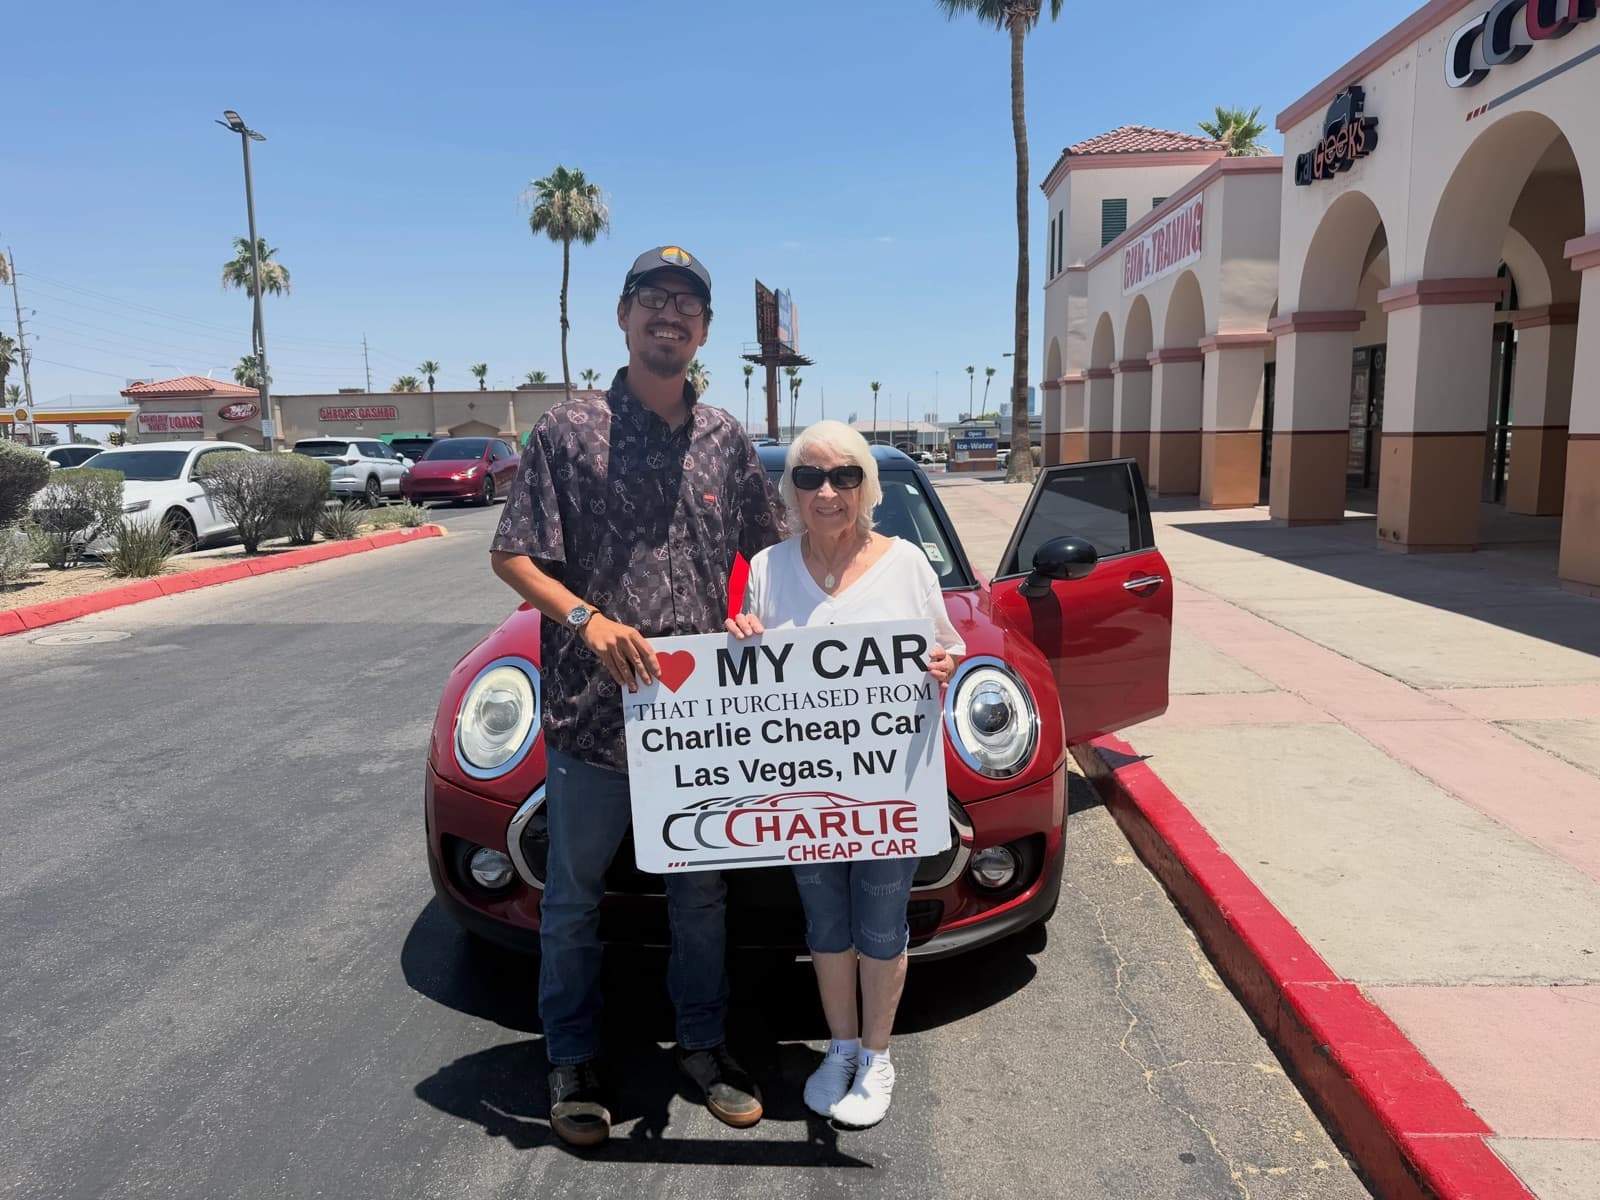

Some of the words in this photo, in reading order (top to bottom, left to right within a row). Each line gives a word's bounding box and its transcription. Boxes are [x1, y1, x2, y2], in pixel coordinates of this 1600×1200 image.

[717, 642, 795, 688] MY
[812, 633, 931, 680] CAR
[633, 699, 699, 721] THAT
[707, 698, 714, 717] I
[721, 688, 859, 716] PURCHASED
[865, 682, 933, 705] FROM
[642, 721, 751, 753] Charlie
[761, 717, 861, 745] Cheap
[871, 711, 926, 737] Car
[675, 763, 730, 789] Las
[739, 758, 843, 789] Vegas,
[853, 749, 898, 776] NV
[787, 841, 863, 862] CHEAP
[871, 838, 918, 857] CAR
